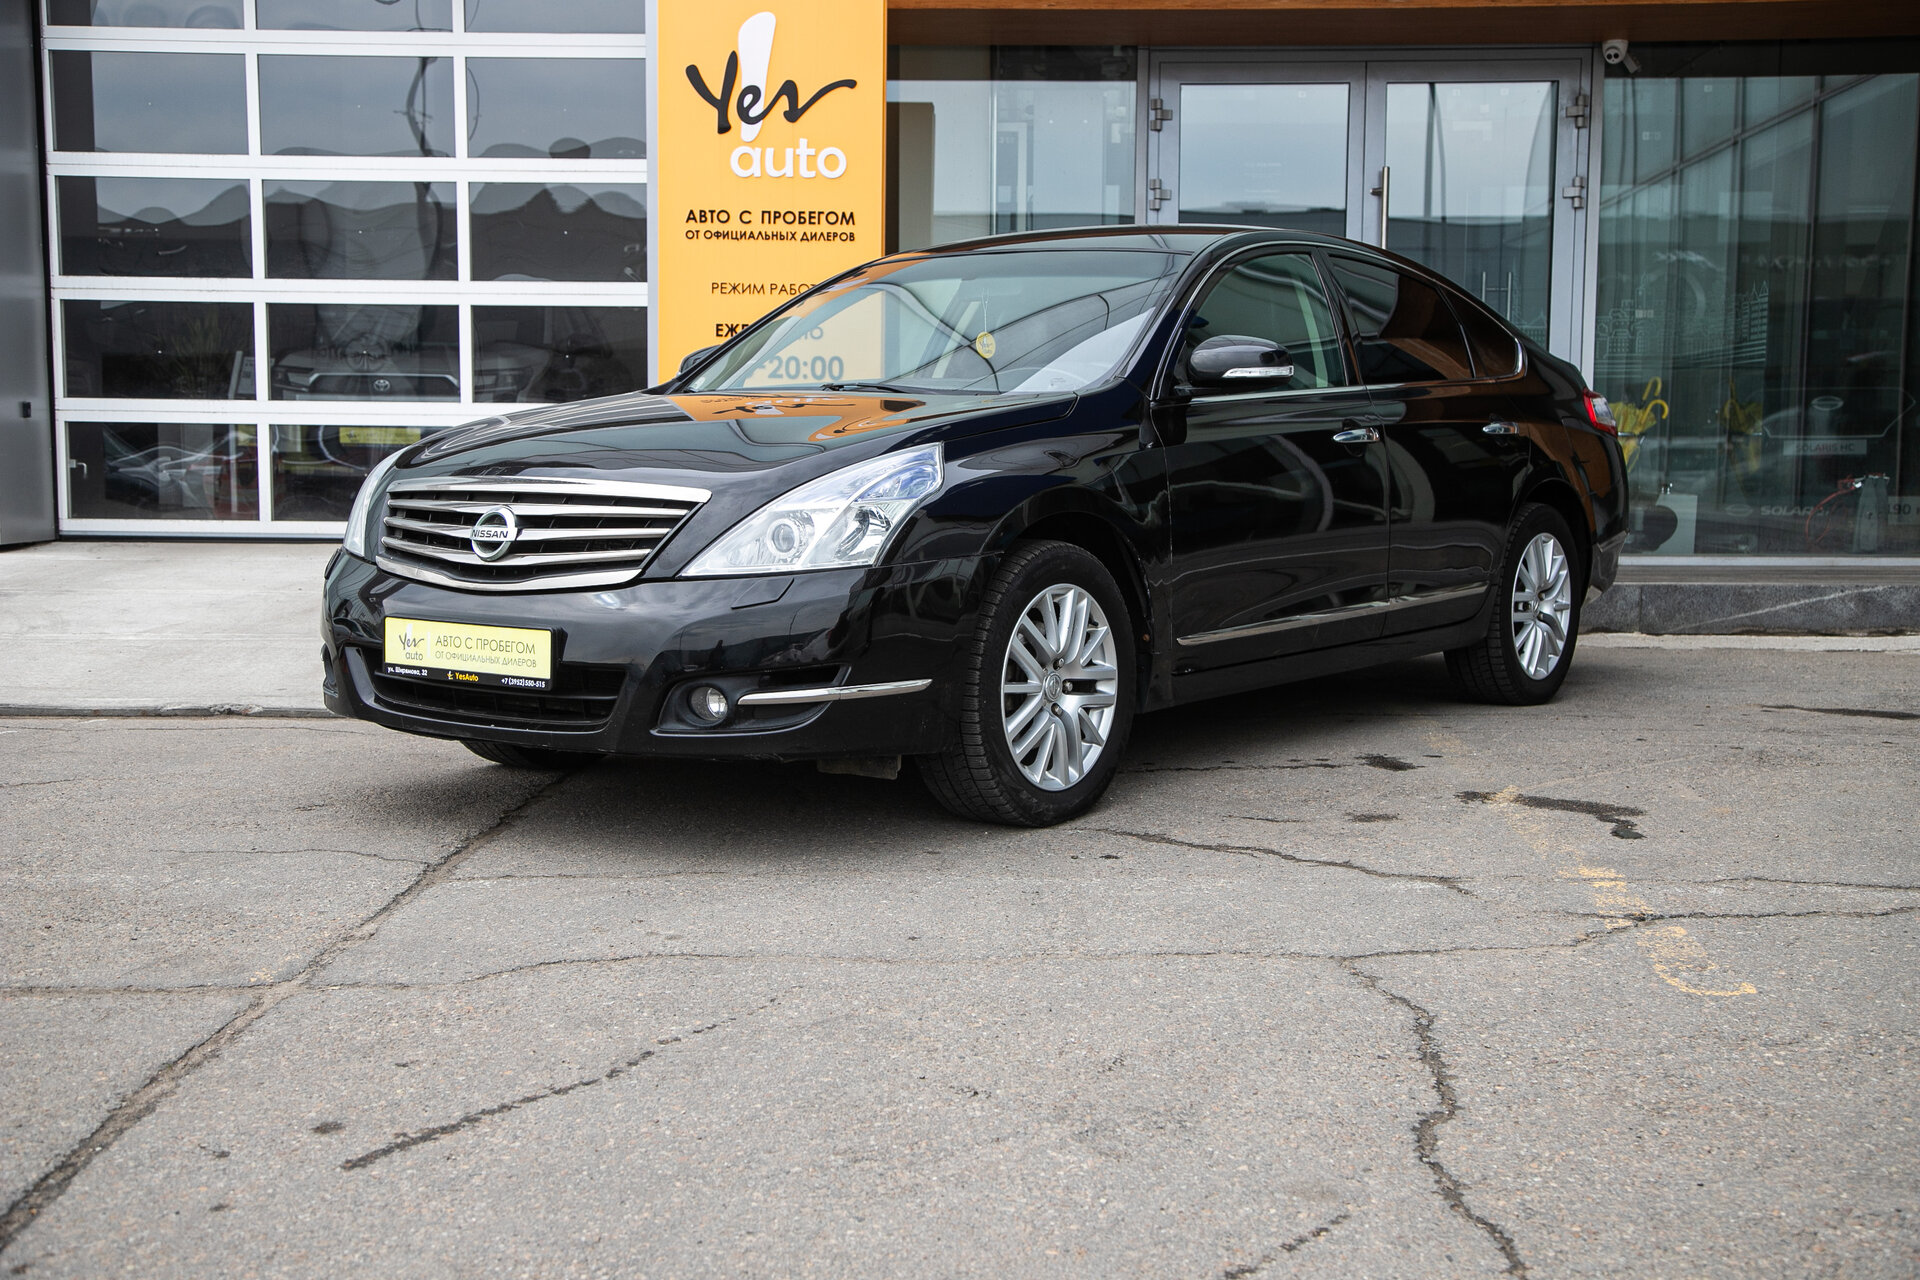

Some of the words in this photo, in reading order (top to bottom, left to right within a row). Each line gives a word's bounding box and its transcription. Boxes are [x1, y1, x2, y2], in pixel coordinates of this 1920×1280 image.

[685, 50, 857, 135] Yes
[729, 138, 848, 179] auto
[685, 209, 730, 225] АВТО
[738, 210, 752, 225] С
[760, 210, 856, 226] ПРОБЕГОМ
[685, 229, 700, 240] ОТ
[703, 229, 797, 242] ОФИЦИАЛЬНЫХ
[800, 230, 856, 243] ДИЛЕРОВ
[711, 282, 765, 295] РЕЖИМ
[472, 529, 509, 539] NISSAN
[398, 632, 425, 650] Yes
[435, 635, 462, 649] АВТО
[465, 637, 473, 650] С
[476, 638, 536, 655] ПРОБЕГОМ
[405, 651, 424, 661] auto
[435, 650, 444, 660] ОТ
[446, 652, 501, 665] ОФИЦИАЛЬНЫХ
[502, 657, 537, 668] ДИЛЕРОВ
[455, 672, 479, 682] YesAuto
